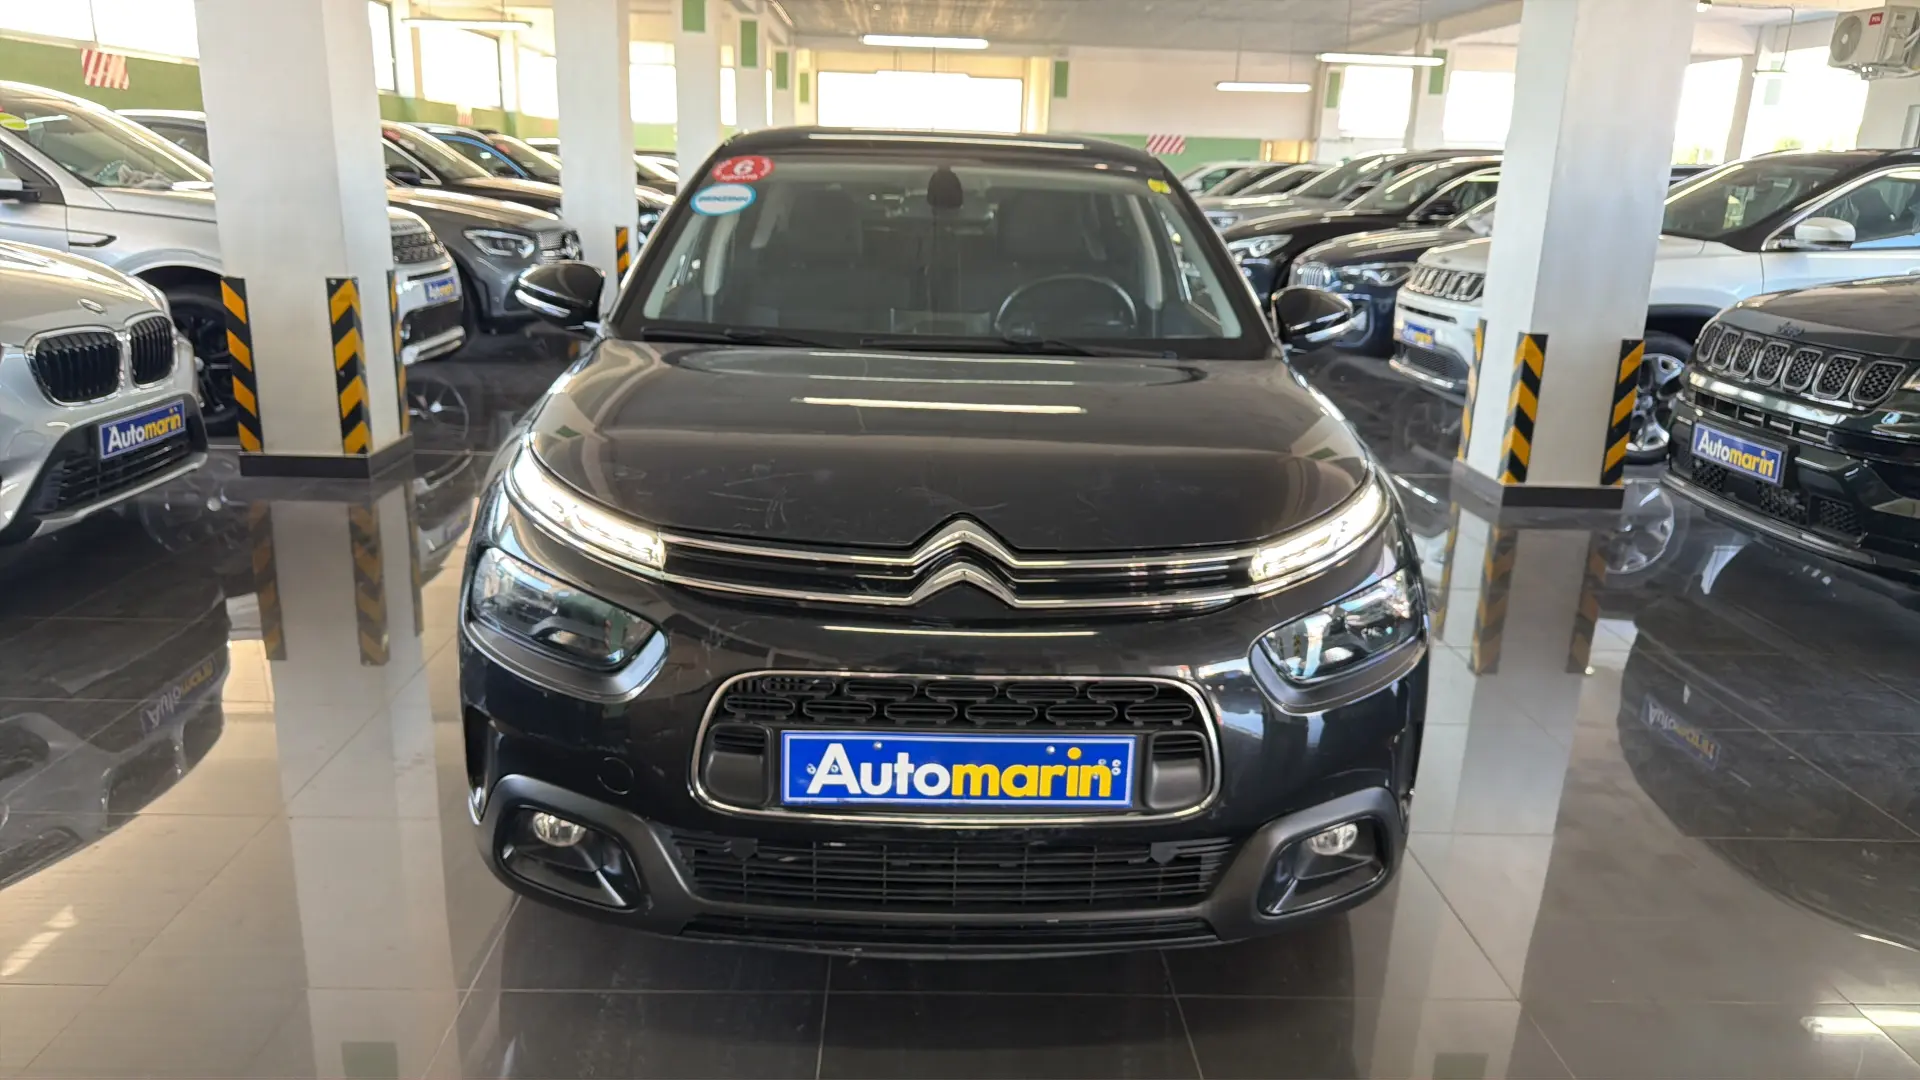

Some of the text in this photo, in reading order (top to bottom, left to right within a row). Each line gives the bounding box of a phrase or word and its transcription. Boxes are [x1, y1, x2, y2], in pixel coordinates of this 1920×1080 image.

[107, 408, 181, 452] Automarin
[1698, 430, 1774, 477] Automarin
[806, 743, 1112, 797] Automarin
